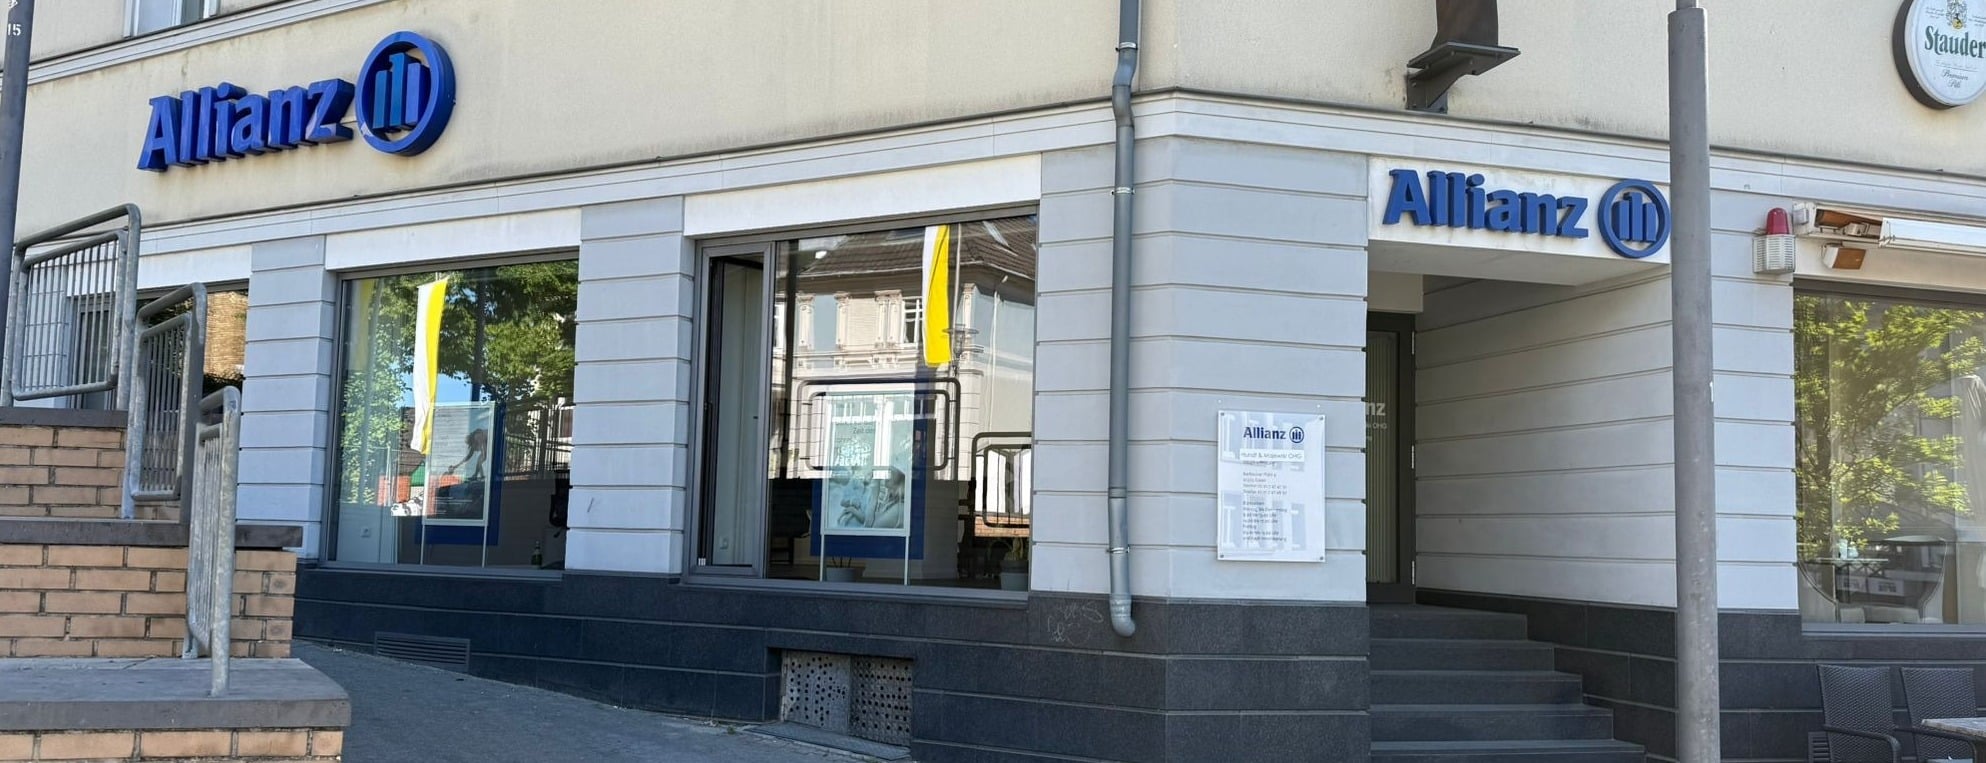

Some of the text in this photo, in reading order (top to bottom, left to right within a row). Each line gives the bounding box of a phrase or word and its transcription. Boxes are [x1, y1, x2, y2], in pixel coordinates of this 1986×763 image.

[7, 23, 22, 36] 15
[1924, 25, 1986, 59] Stauder
[137, 77, 356, 172] Allianz
[1382, 168, 1589, 239] Allianz
[1243, 426, 1287, 440] Allianz
